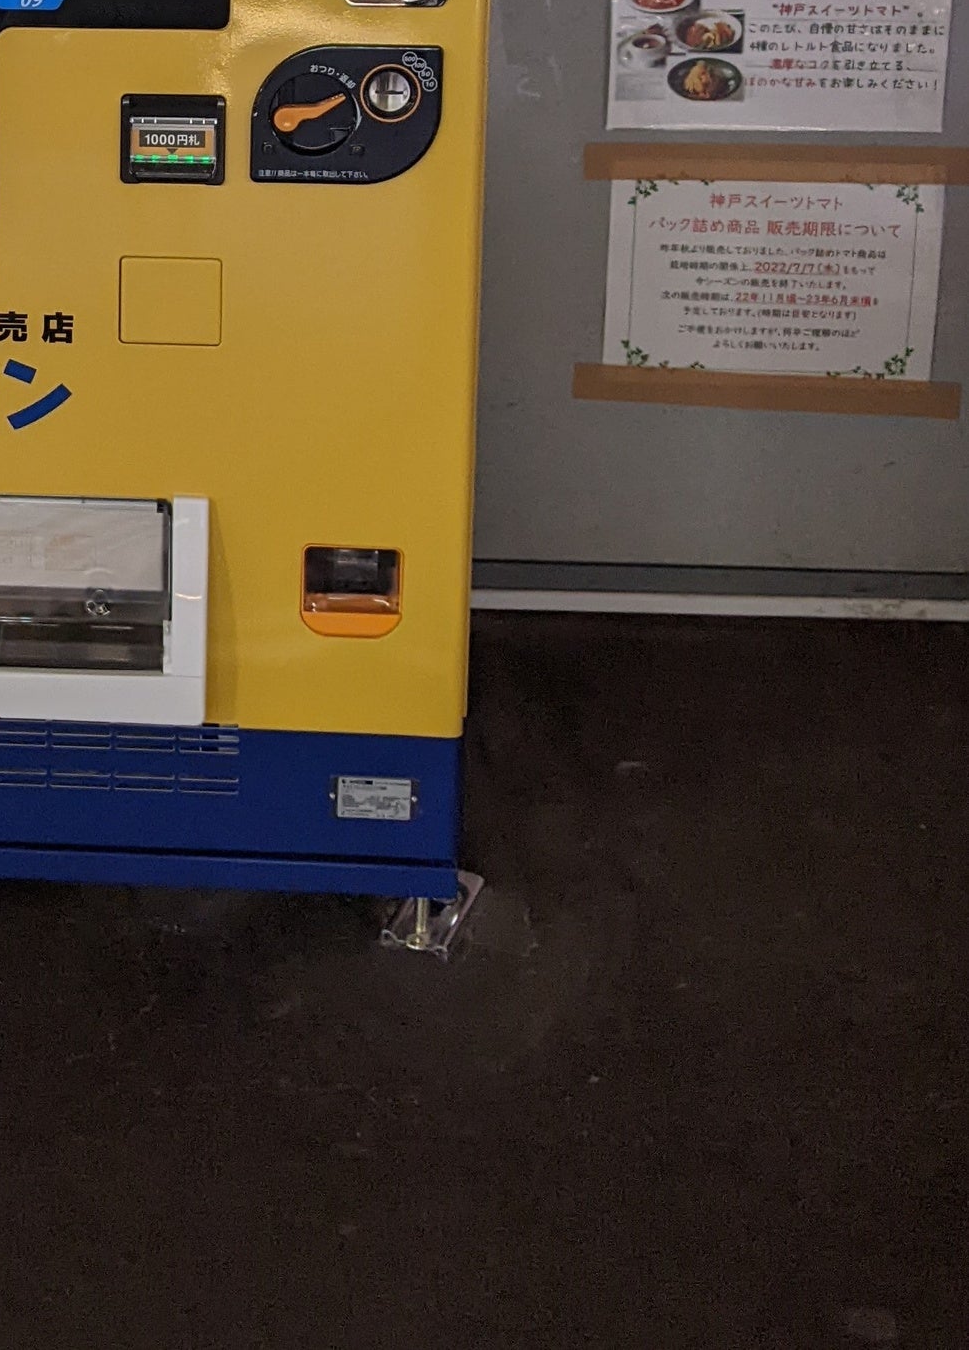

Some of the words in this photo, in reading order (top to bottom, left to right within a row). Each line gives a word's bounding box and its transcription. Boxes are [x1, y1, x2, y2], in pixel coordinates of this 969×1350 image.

[144, 133, 200, 146] 1000円札
[709, 193, 843, 211] 神戸スイーツトマト
[650, 217, 760, 235] パック詰め商品
[767, 220, 901, 238] 販売期限について
